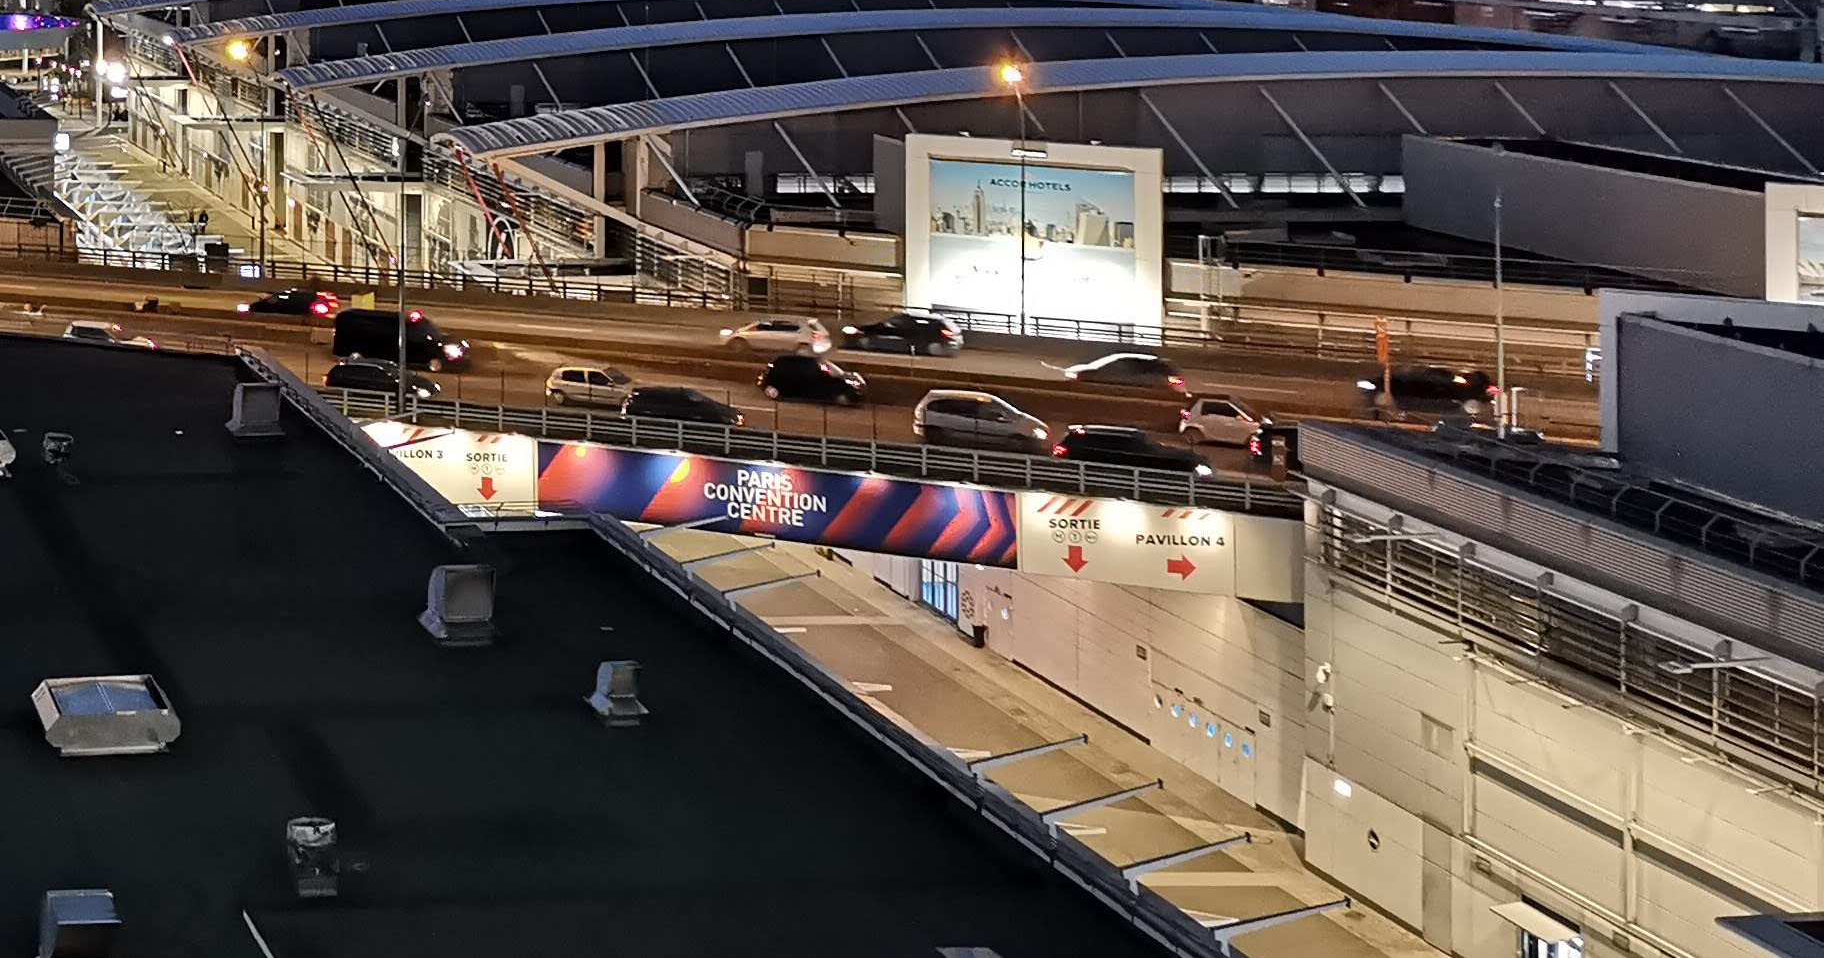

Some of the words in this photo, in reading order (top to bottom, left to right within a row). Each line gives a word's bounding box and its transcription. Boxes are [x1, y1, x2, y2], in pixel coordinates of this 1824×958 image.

[436, 450, 444, 459] 3
[466, 452, 508, 462] SORTIE
[737, 469, 793, 492] PARIS
[704, 482, 827, 513] CONVENTION
[727, 502, 805, 527] CENTRE
[1048, 518, 1101, 530] SORTIE
[1136, 534, 1210, 546] PAVILLON
[1216, 536, 1225, 546] 4
